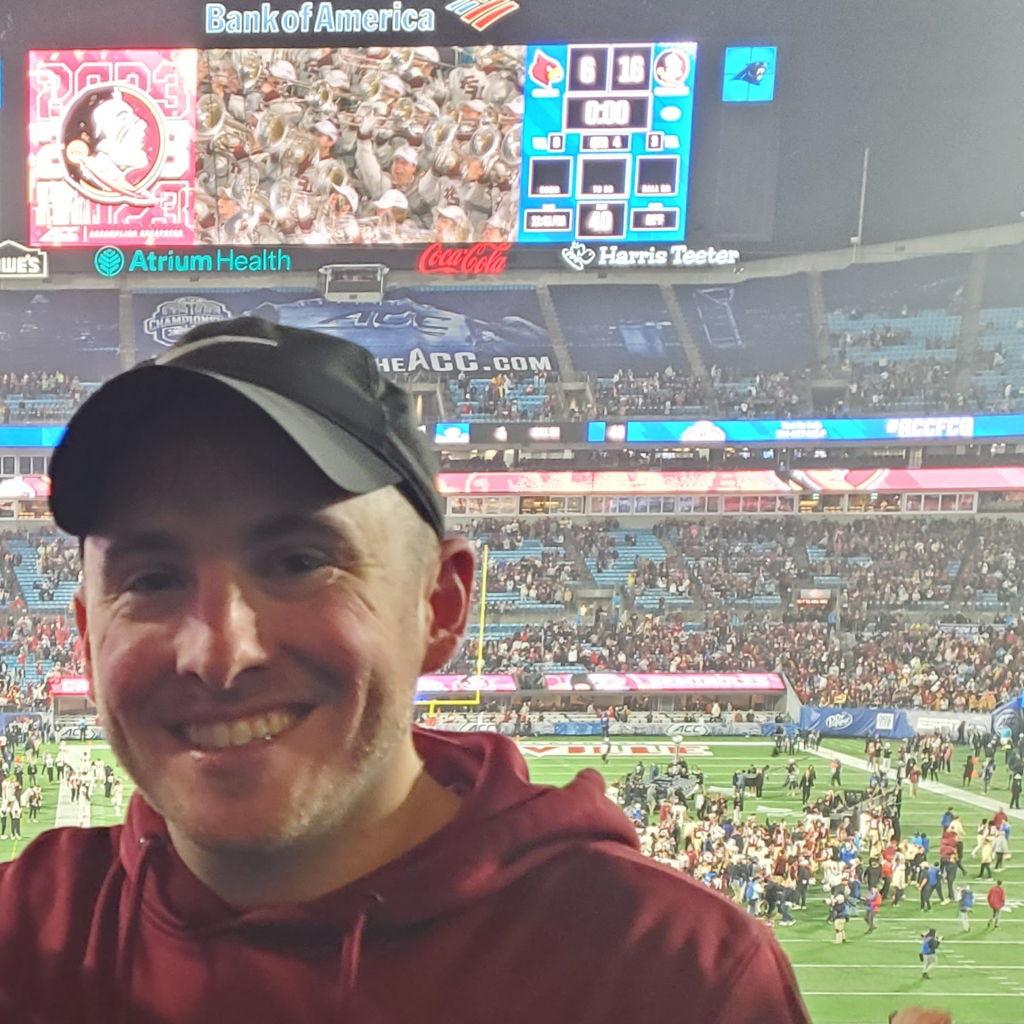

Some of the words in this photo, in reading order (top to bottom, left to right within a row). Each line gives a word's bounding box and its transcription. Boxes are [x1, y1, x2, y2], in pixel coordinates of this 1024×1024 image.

[205, 3, 280, 33] Bank
[280, 2, 313, 32] of
[314, 2, 435, 32] America
[580, 55, 596, 84] 6
[617, 55, 645, 83] 16
[128, 249, 212, 272] Atrium
[217, 249, 291, 272] Health
[598, 246, 668, 266] Harris
[669, 244, 741, 265] Teeter
[374, 347, 553, 372] HEACC.COM
[673, 723, 701, 734] ACC
